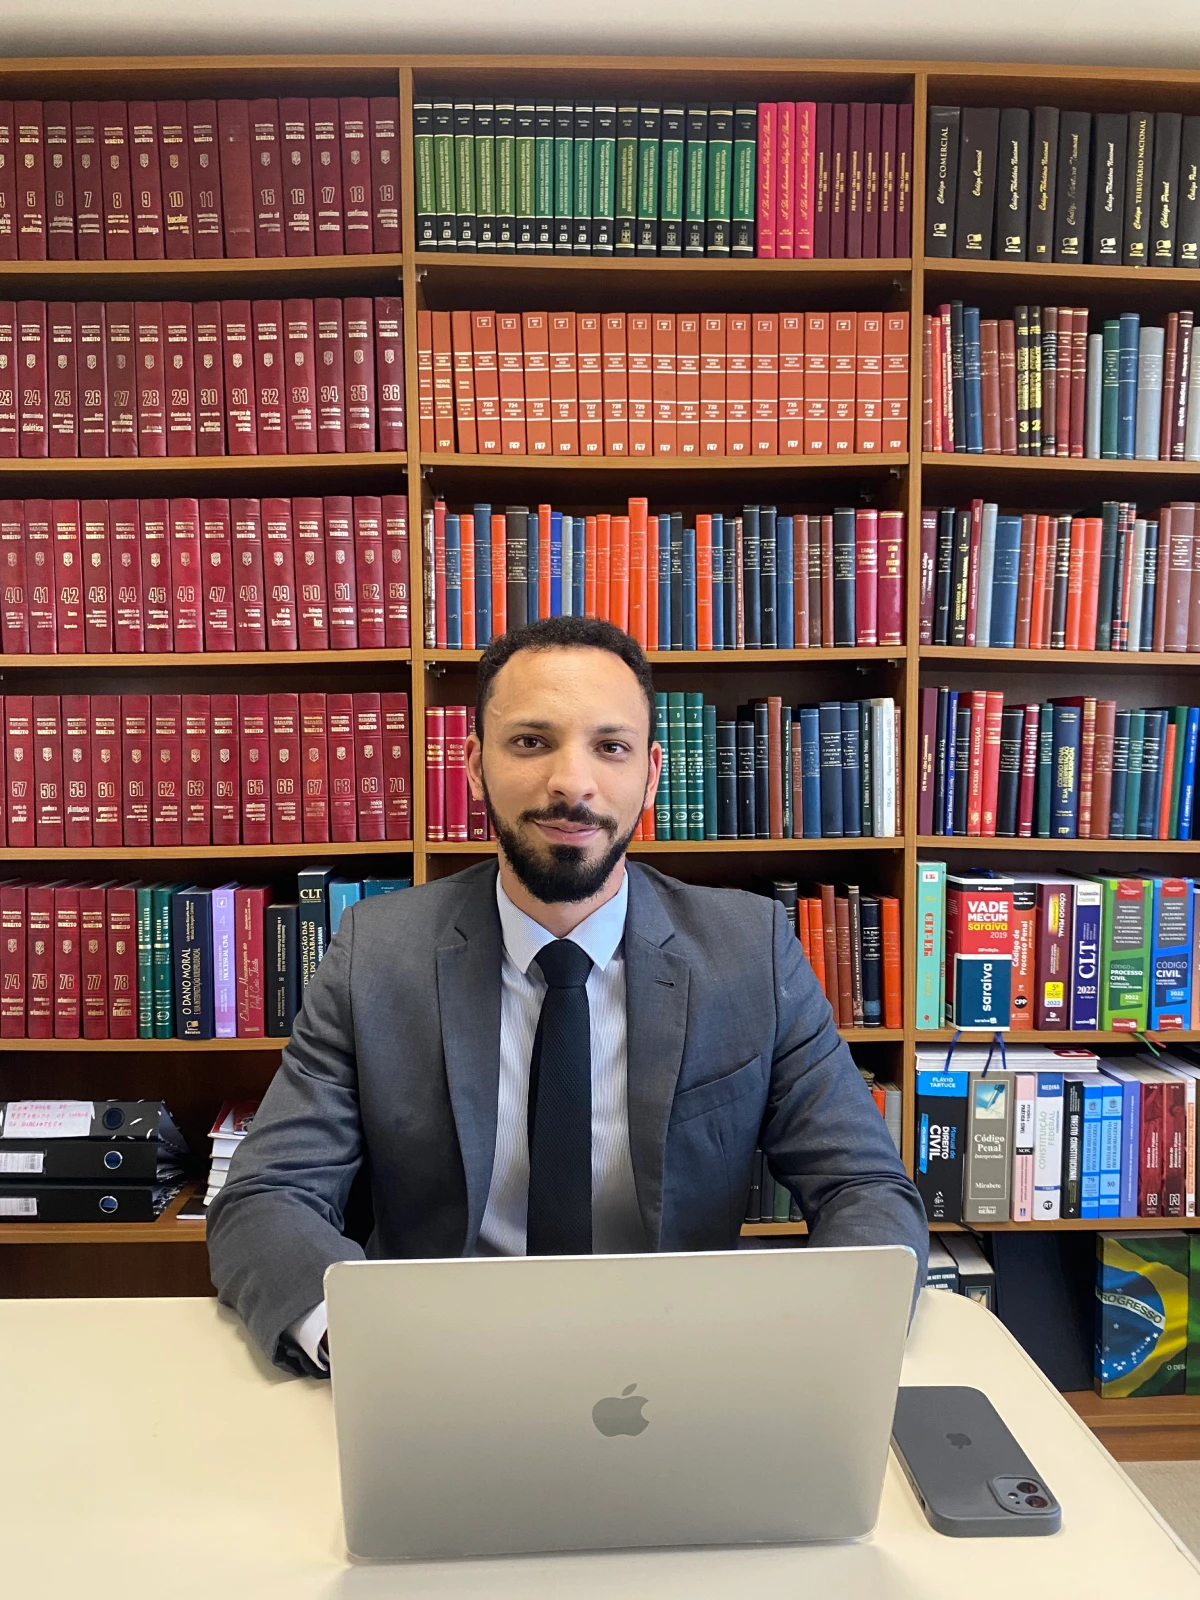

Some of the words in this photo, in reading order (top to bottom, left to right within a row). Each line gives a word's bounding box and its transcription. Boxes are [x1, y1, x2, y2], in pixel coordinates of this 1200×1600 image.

[1138, 119, 1146, 158] NACIONAL
[939, 127, 948, 178] COMERCIAL
[972, 177, 983, 196] Código
[1135, 160, 1144, 203] TRIBUTÁRIO
[26, 191, 35, 207] 5
[55, 191, 64, 207] 6
[261, 189, 275, 205] 15
[291, 189, 305, 204] 16
[321, 186, 335, 204] 17
[349, 186, 364, 203] 18
[379, 185, 394, 202] 19
[936, 181, 945, 204] Código
[1161, 182, 1170, 202] Penal
[1187, 181, 1197, 201] Código
[83, 191, 92, 208] 7
[112, 192, 122, 208] 8
[141, 191, 151, 208] 9
[169, 191, 183, 208] 10
[200, 191, 214, 208] 11
[1009, 192, 1019, 210] Código
[1104, 194, 1114, 212] Código
[1132, 206, 1142, 229] Código
[1160, 204, 1170, 228] Código
[24, 390, 41, 406] 24
[54, 390, 72, 406] 25
[85, 390, 101, 406] 26
[114, 391, 129, 407] 27
[142, 390, 159, 407] 28
[172, 390, 189, 406] 29
[200, 390, 218, 406] 30
[232, 388, 248, 404] 31
[262, 388, 279, 404] 32
[292, 387, 309, 404] 33
[321, 386, 339, 402] 34
[351, 385, 368, 402] 35
[382, 384, 400, 400] 36
[1020, 420, 1029, 432] 3
[1032, 419, 1041, 431] 2
[5, 587, 23, 604] 40
[34, 587, 49, 603] 41
[61, 587, 79, 604] 42
[89, 587, 107, 603] 43
[118, 587, 136, 603] 44
[148, 587, 166, 604] 45
[177, 586, 195, 602] 46
[209, 586, 225, 602] 47
[240, 585, 257, 601] 48
[273, 585, 290, 602] 49
[302, 584, 320, 601] 50
[334, 583, 350, 600] 51
[363, 583, 380, 599] 52
[389, 583, 406, 599] 53
[974, 758, 980, 766] DE
[11, 781, 27, 797] 57
[40, 782, 57, 799] 58
[69, 781, 87, 798] 59
[98, 781, 115, 798] 60
[129, 780, 145, 797] 61
[158, 781, 174, 796] 62
[187, 780, 204, 797] 63
[216, 781, 233, 797] 64
[247, 779, 264, 795] 65
[276, 779, 293, 794] 66
[306, 779, 322, 795] 67
[334, 778, 350, 794] 68
[362, 777, 379, 793] 69
[390, 777, 404, 793] 70
[300, 889, 322, 899] CLT
[968, 901, 1008, 912] VADE
[968, 913, 1008, 922] MECUM
[968, 923, 1008, 931] saraiva
[1013, 930, 1020, 939] de
[1020, 920, 1028, 942] Penal
[1012, 940, 1021, 967] Código
[1020, 943, 1028, 975] Processo
[1079, 941, 1096, 979] CLT
[181, 948, 191, 978] MORAL
[310, 962, 315, 972] DO
[1156, 961, 1187, 969] CÓDIGO
[4, 973, 21, 990] 74
[32, 973, 48, 989] 75
[59, 973, 75, 989] 76
[87, 974, 101, 989] 77
[114, 974, 129, 990] 78
[1156, 970, 1181, 978] CIVIL
[182, 980, 192, 1006] DANO
[981, 963, 992, 1012] saraiva
[1077, 986, 1096, 994] 2022
[1014, 998, 1027, 1006] CPP
[112, 1007, 132, 1017] índice
[1048, 1111, 1056, 1147] FEDERAL
[1070, 1115, 1079, 1136] DIREITO
[929, 1124, 941, 1161] CIVIL
[974, 1134, 1005, 1143] Código
[1039, 1110, 1048, 1170] CONSTITUIÇÃO
[978, 1144, 1001, 1152] Penal
[1069, 1138, 1079, 1181] CONSTITUCIONAL
[1097, 1290, 1162, 1324] PROGRESSO
